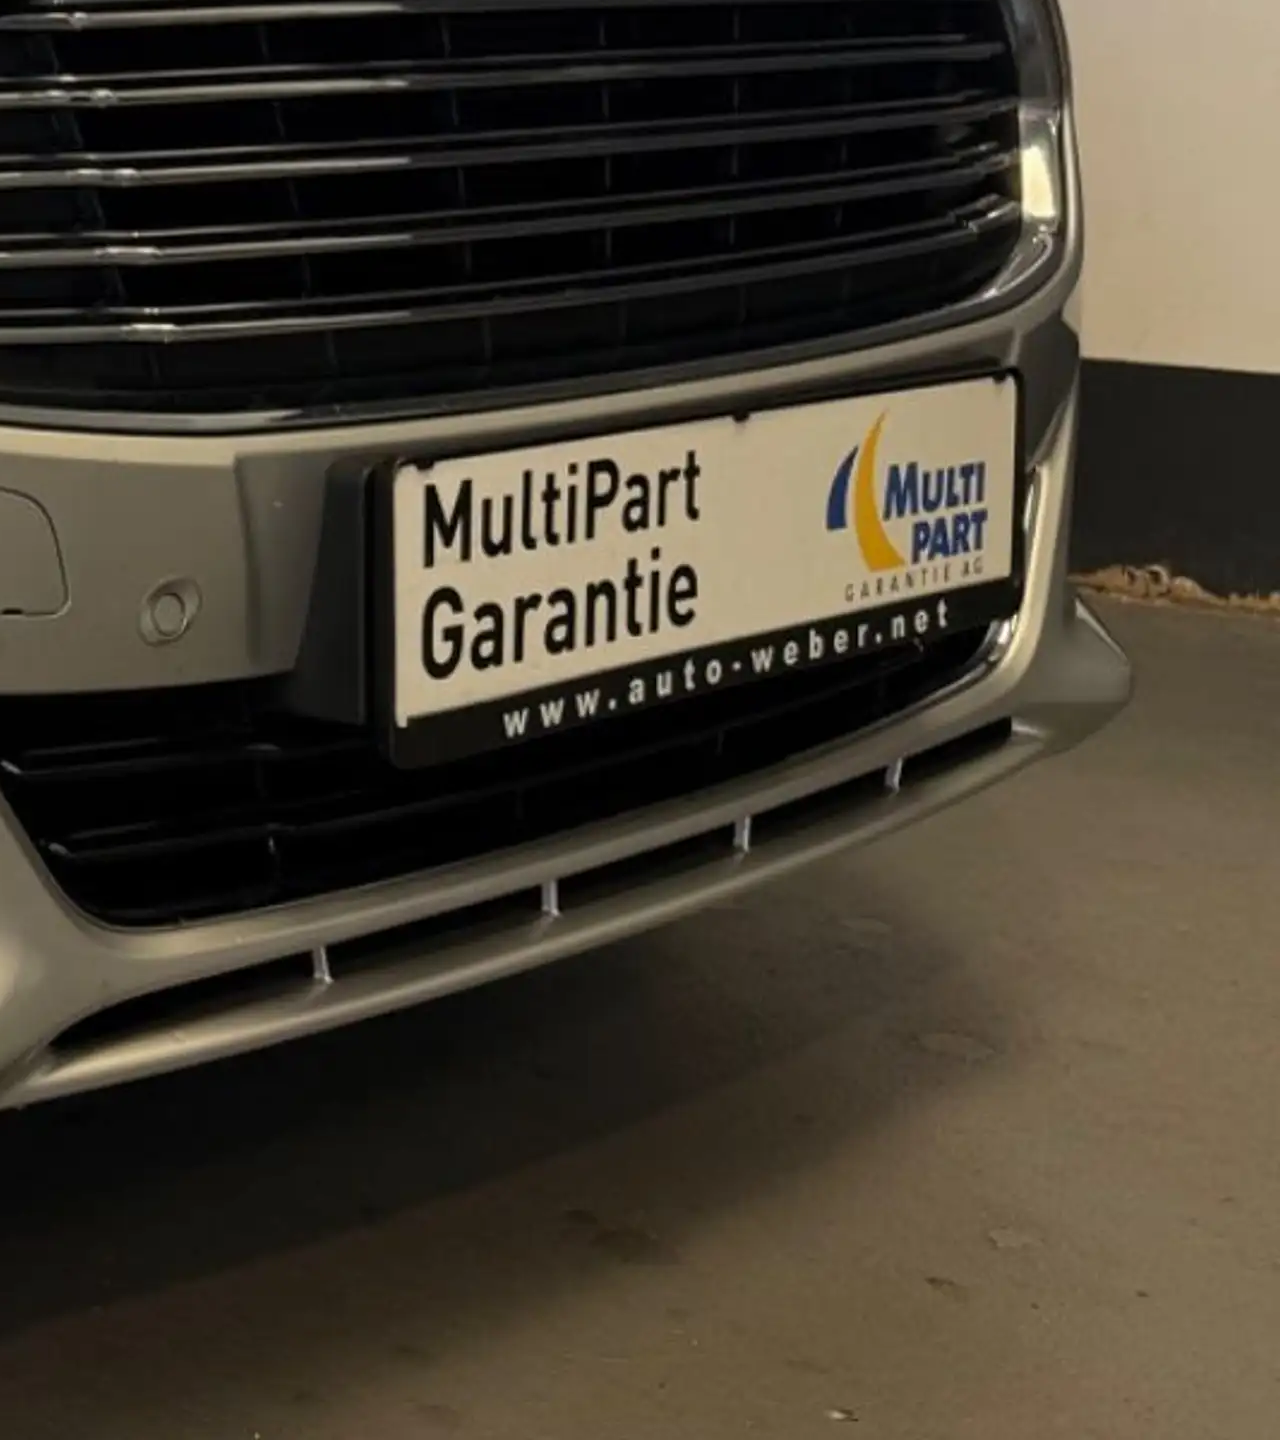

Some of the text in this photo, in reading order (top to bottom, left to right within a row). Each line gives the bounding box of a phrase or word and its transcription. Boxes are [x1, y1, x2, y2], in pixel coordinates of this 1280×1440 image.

[422, 450, 700, 569] MultiPart
[882, 461, 987, 521] MULTI
[844, 556, 983, 602] GARANTIE AG
[910, 508, 989, 565] PART
[421, 546, 698, 680] Garantie
[503, 599, 949, 740] www.auto-weber.net
